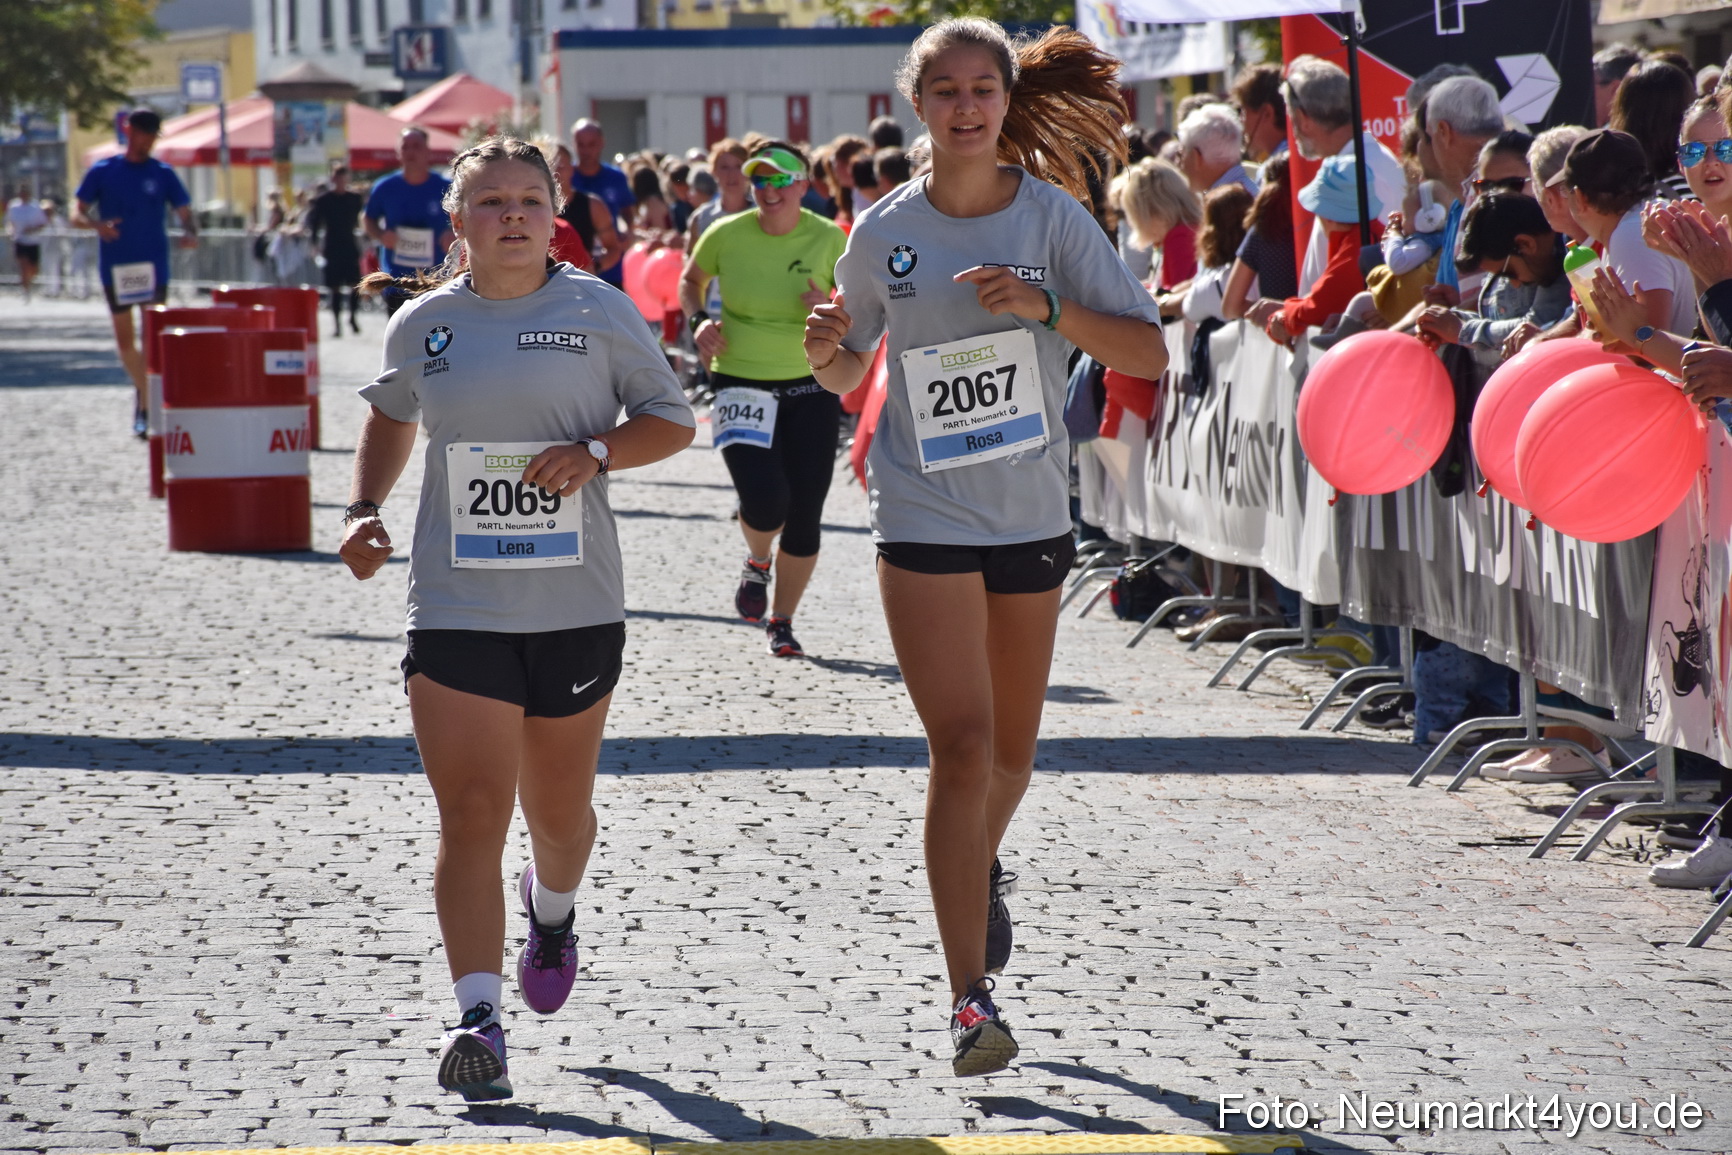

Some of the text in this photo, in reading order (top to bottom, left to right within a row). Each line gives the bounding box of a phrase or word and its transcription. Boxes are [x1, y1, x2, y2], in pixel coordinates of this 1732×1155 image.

[983, 263, 1046, 281] CK
[888, 282, 916, 294] PARTL
[889, 289, 916, 300] Neumarkt
[518, 331, 588, 350] BOCK
[424, 357, 449, 372] PARTL
[940, 344, 998, 368] BOCK
[423, 366, 450, 378] Neumarkt
[927, 363, 1017, 418] 2067
[718, 403, 764, 425] 2044
[942, 410, 1007, 430] PARTL Neumarkt
[966, 431, 1004, 451] Rosa
[468, 478, 561, 517] 2069
[477, 521, 544, 530] PARTL Neumarkt
[497, 539, 535, 555] Lena
